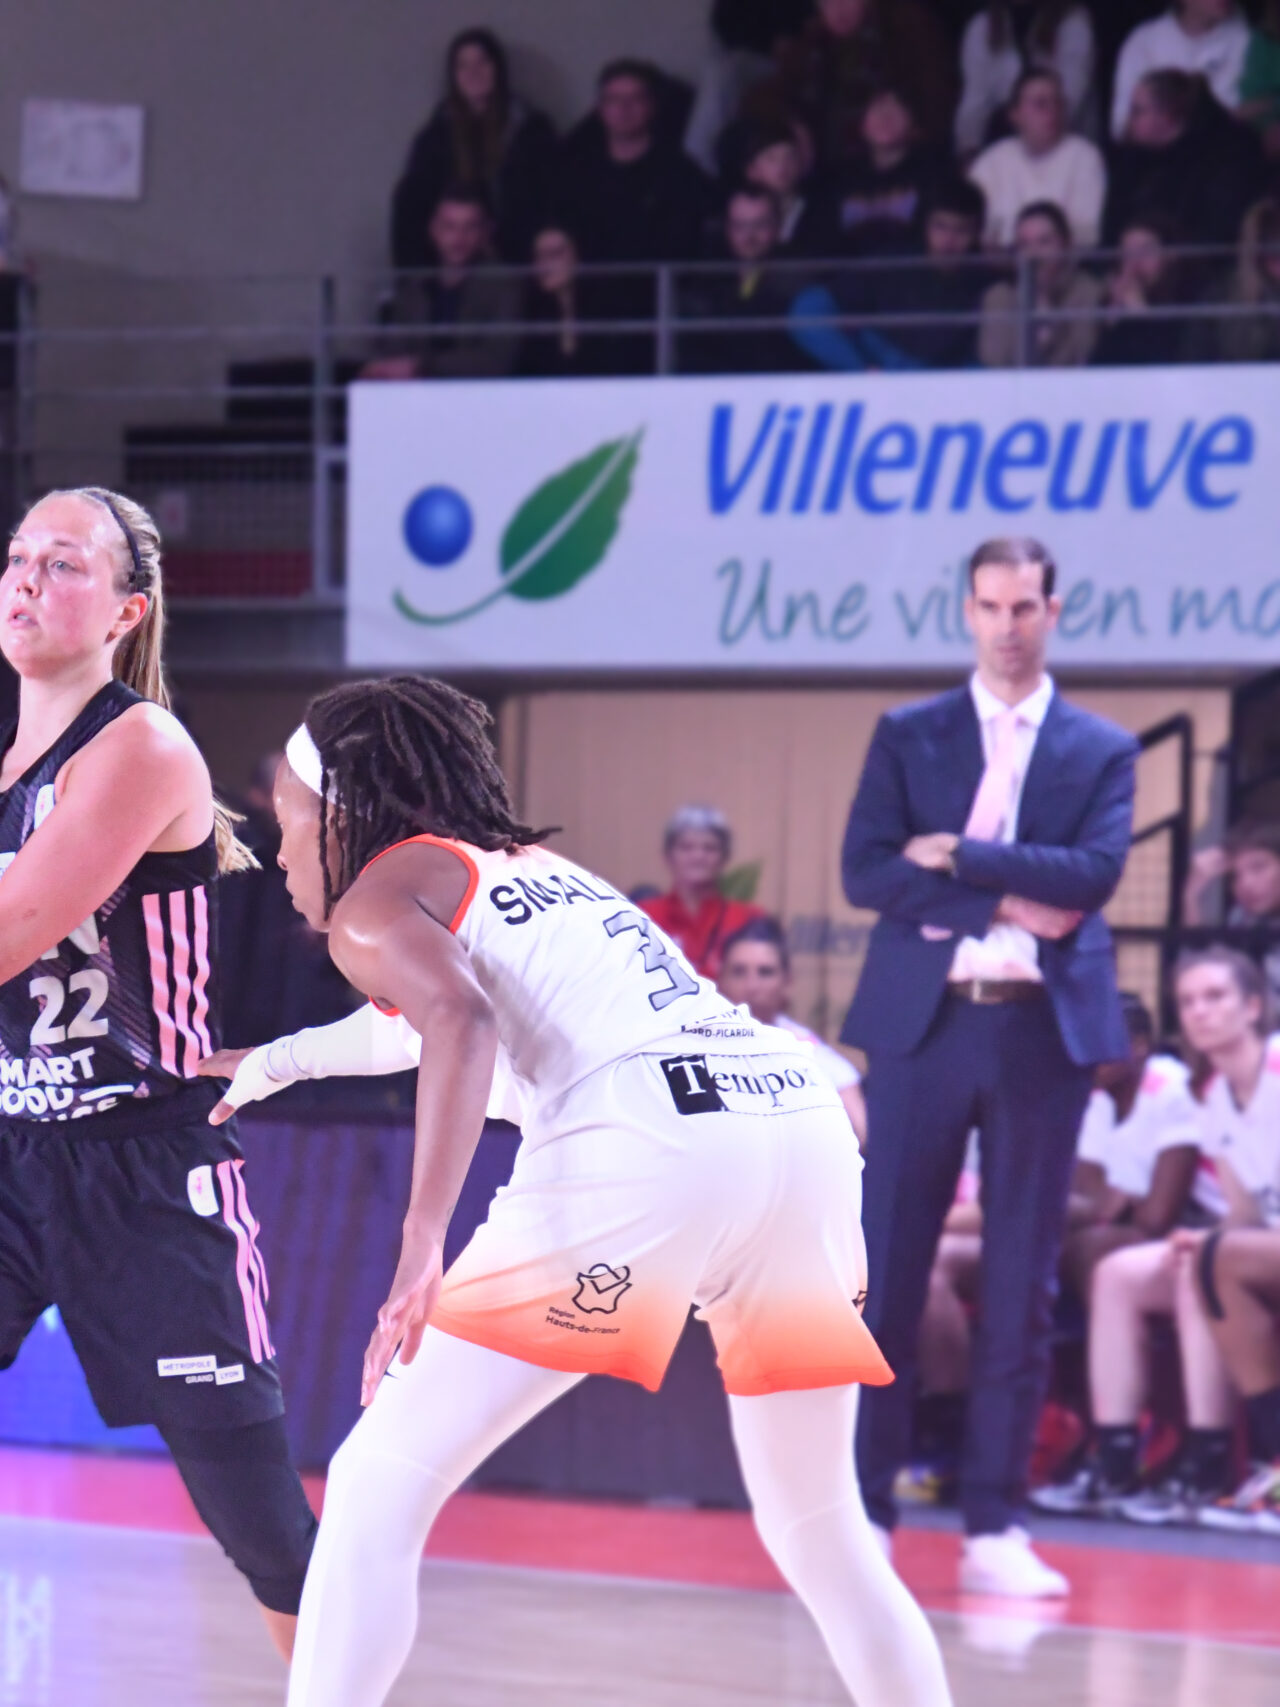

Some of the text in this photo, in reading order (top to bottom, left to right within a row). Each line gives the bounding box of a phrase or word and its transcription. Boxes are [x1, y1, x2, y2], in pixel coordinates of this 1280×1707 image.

[707, 401, 1255, 516] Villeneuve
[715, 557, 872, 645] Une
[893, 551, 972, 644] vil
[1059, 577, 1148, 641] en
[29, 968, 109, 1046] 22
